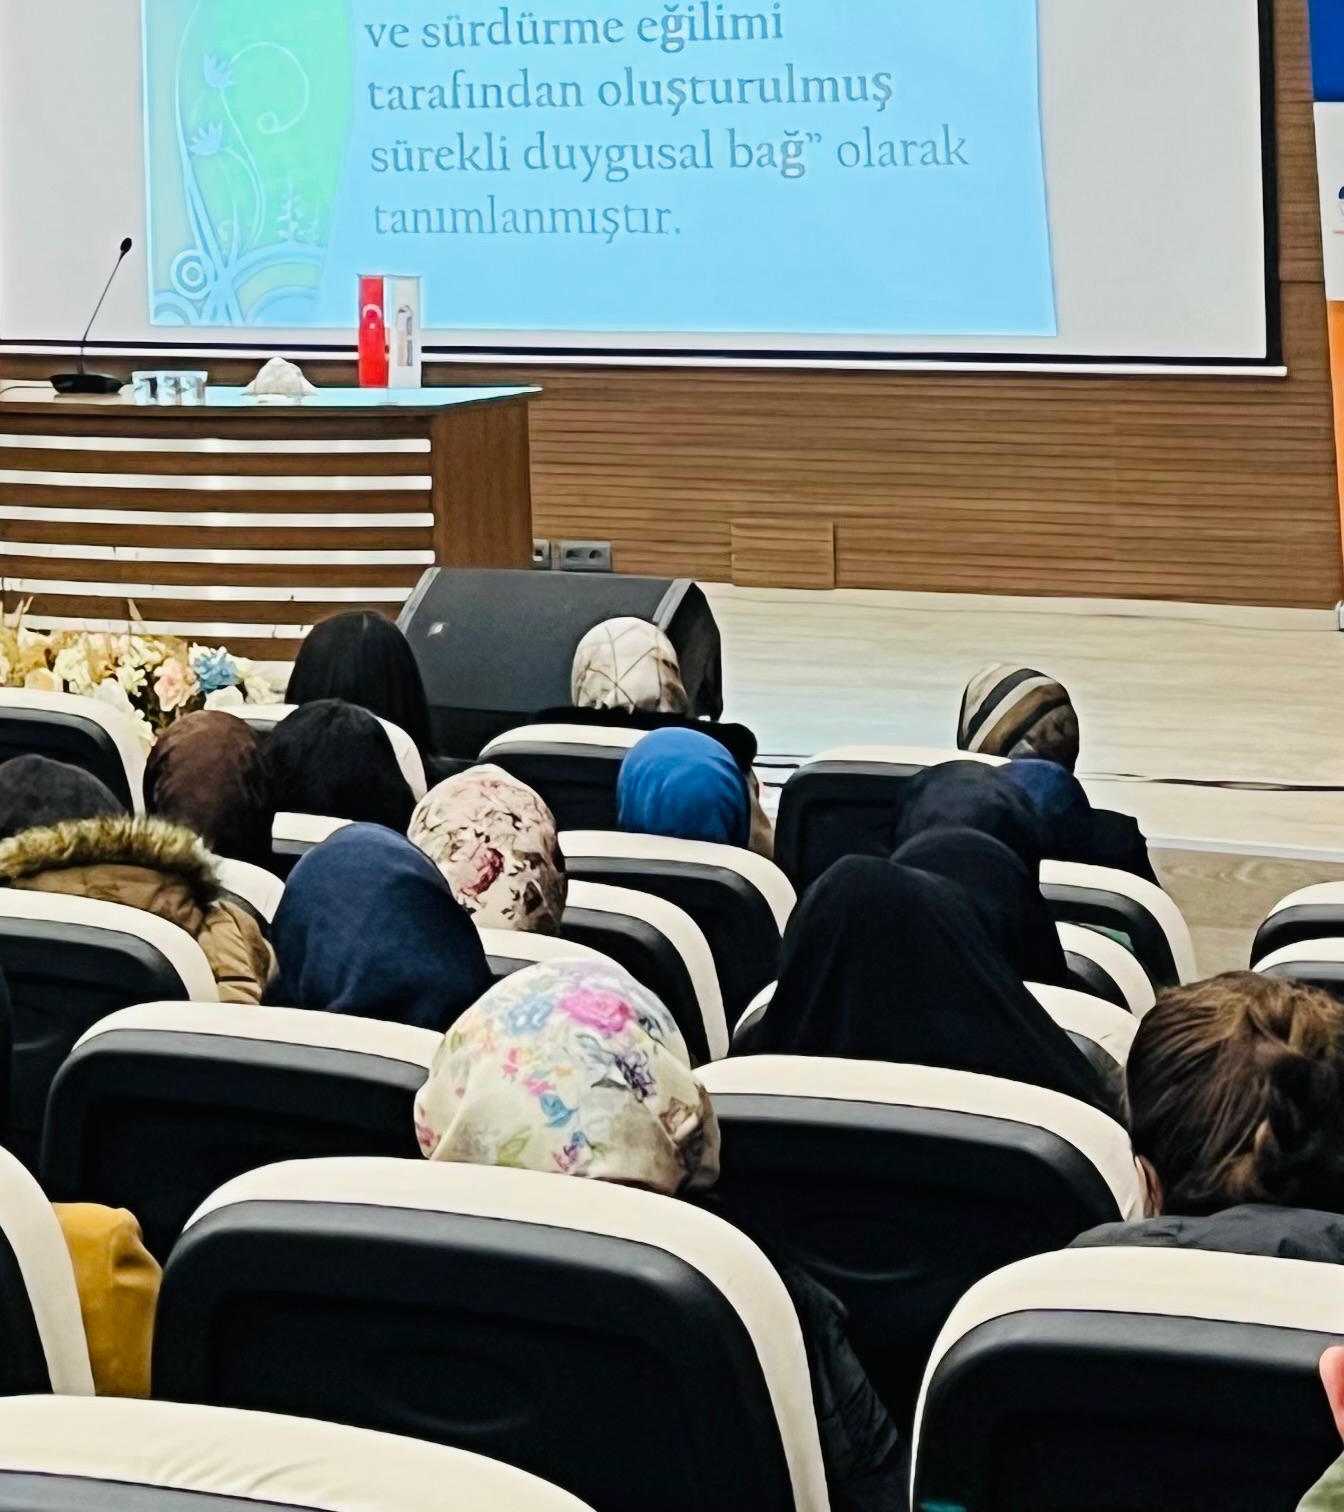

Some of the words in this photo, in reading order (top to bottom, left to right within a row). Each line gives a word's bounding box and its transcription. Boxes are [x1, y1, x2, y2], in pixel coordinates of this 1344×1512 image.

[363, 22, 411, 49] ve
[420, 6, 626, 49] sürdürme
[635, 0, 784, 54] eğilimi
[367, 66, 584, 111] tarafından
[596, 62, 893, 117] oluşturulmuş
[370, 130, 512, 173] sürekli
[522, 128, 715, 183] duygusal
[836, 122, 970, 168] olarak
[373, 194, 681, 244] tanımlanmıştır.
